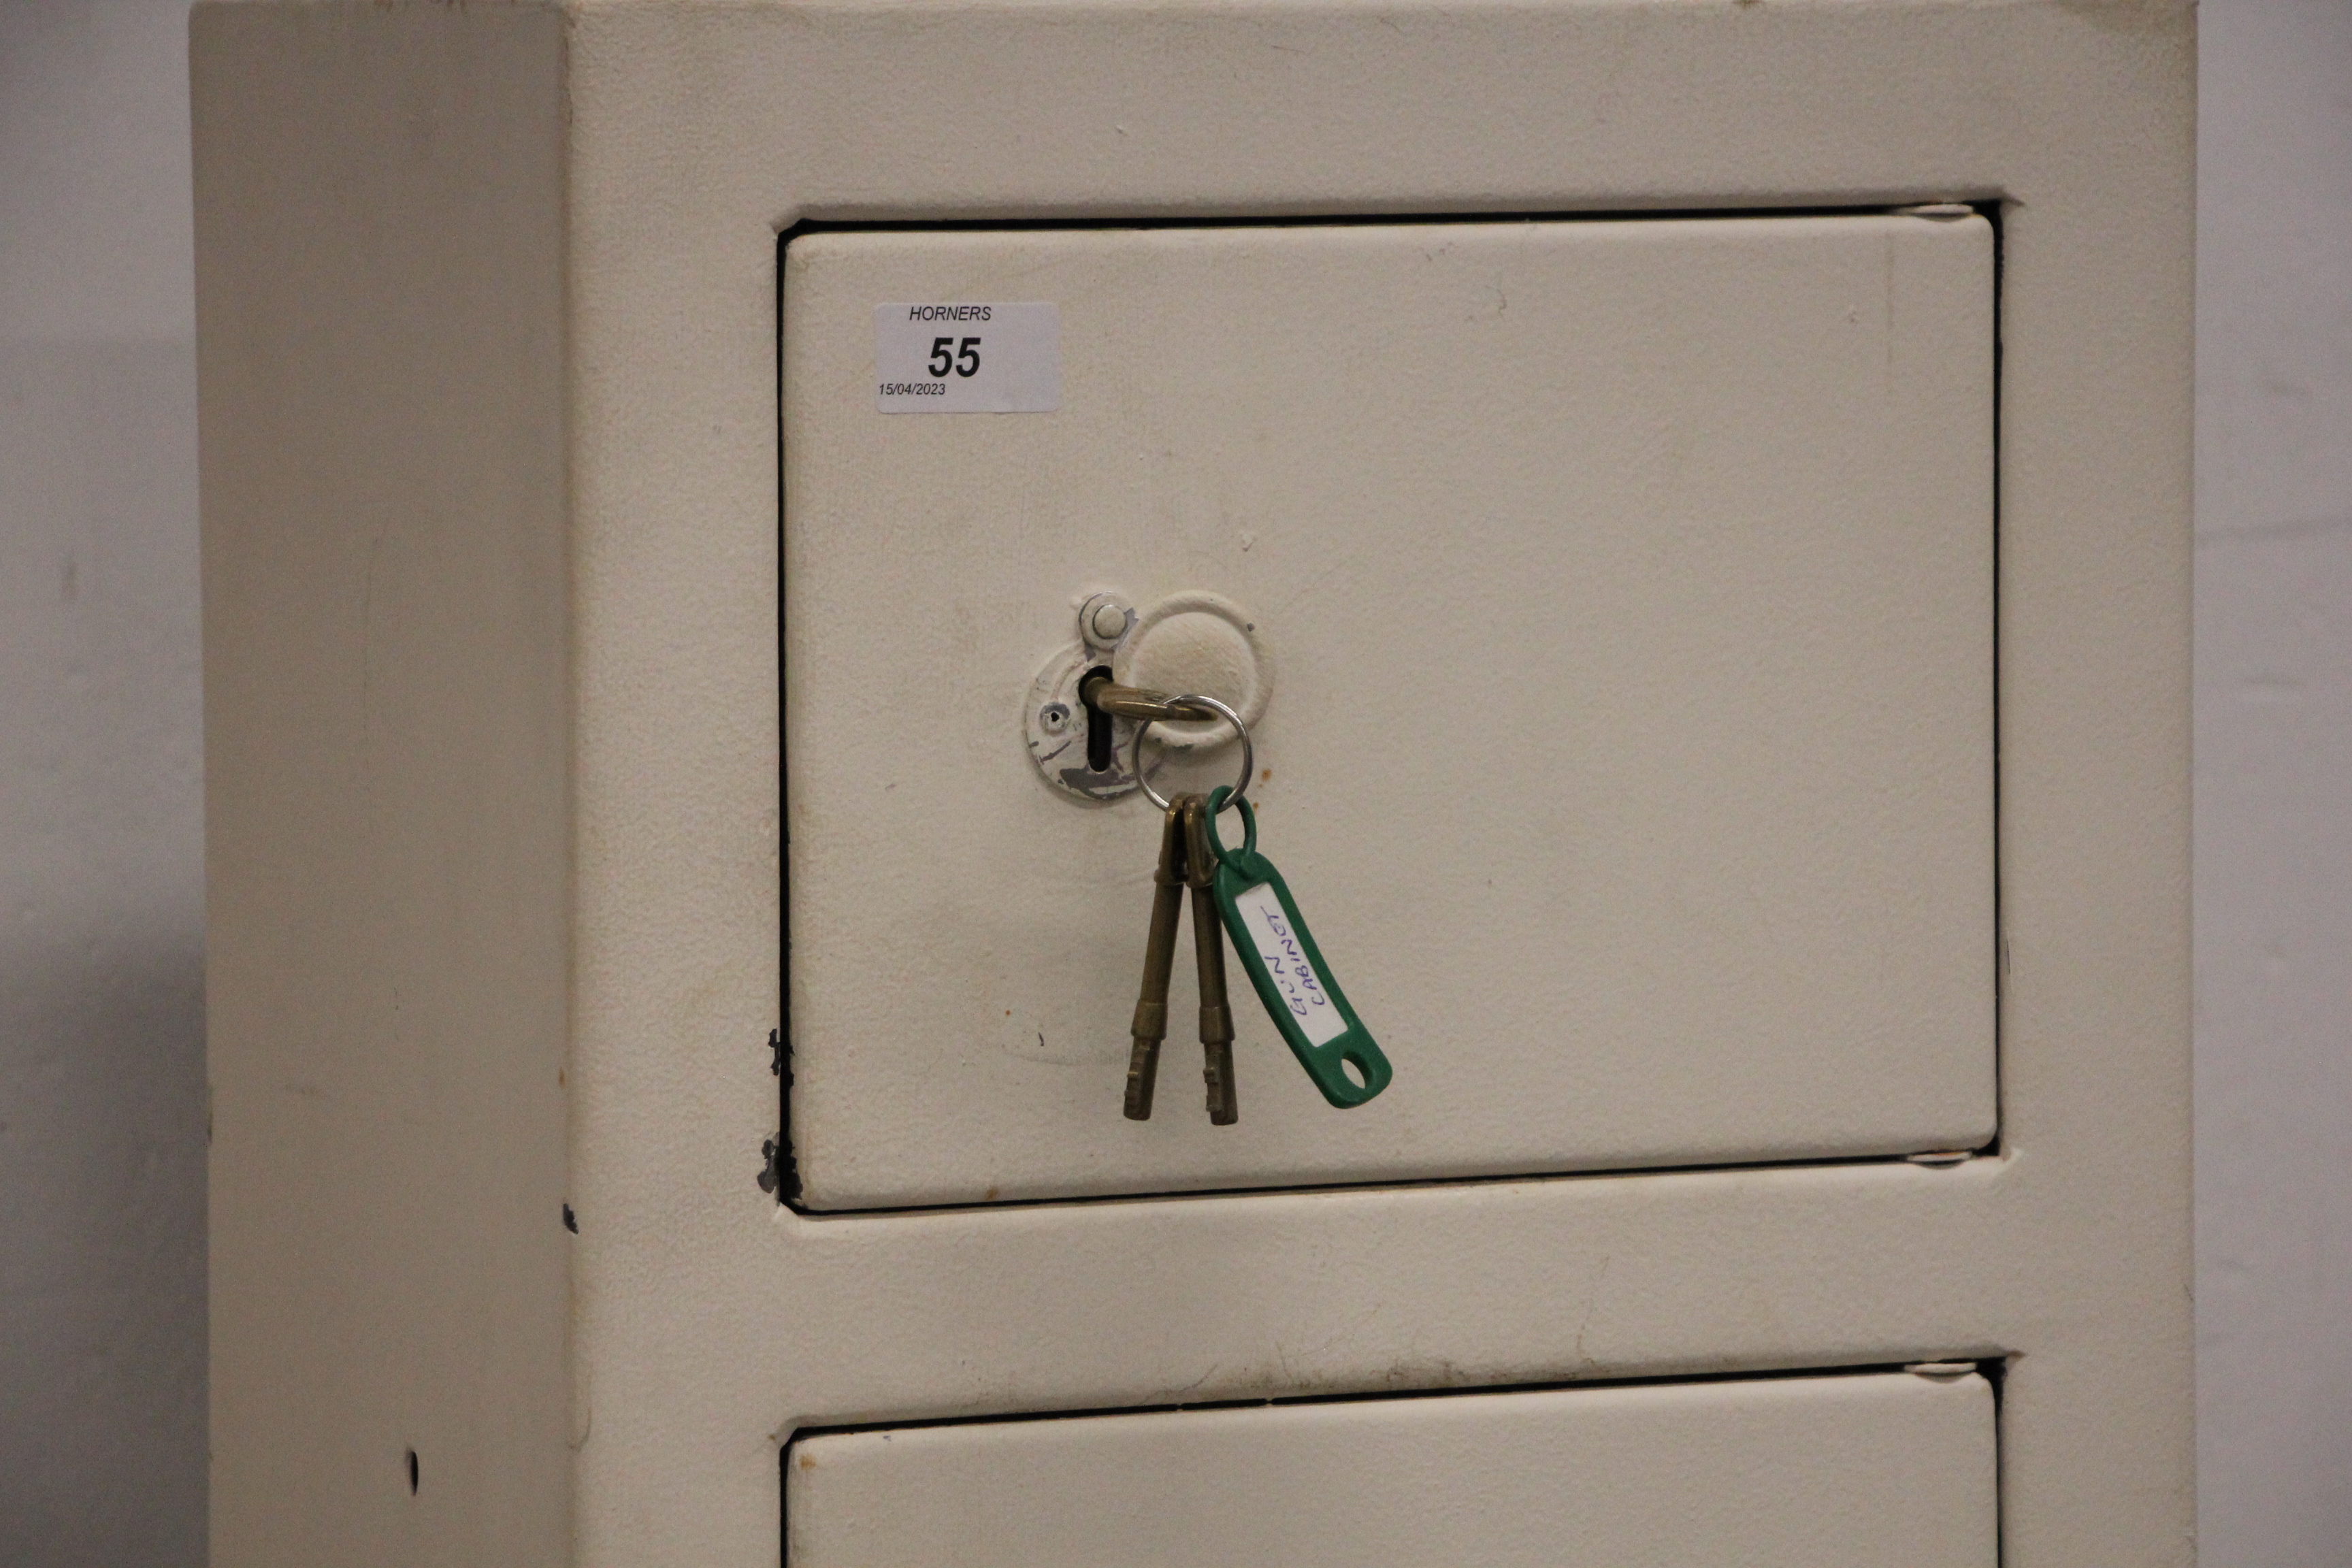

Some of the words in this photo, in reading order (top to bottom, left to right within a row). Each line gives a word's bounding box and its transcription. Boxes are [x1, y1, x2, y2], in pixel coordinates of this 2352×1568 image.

[909, 306, 992, 321] HORNERS
[928, 337, 981, 378] 55
[879, 383, 946, 395] 15/04/2023
[1260, 905, 1325, 1006] CABINET
